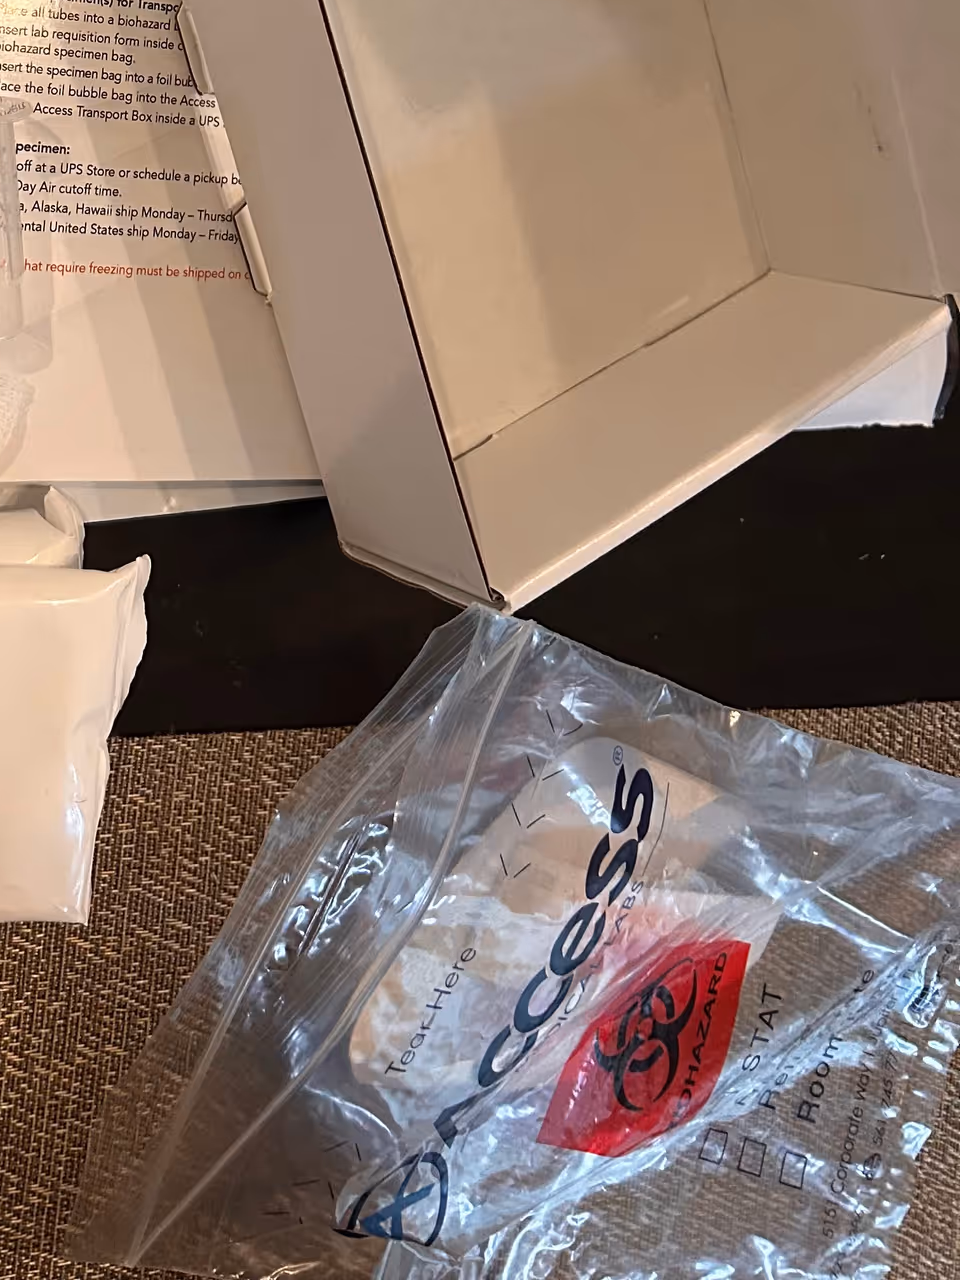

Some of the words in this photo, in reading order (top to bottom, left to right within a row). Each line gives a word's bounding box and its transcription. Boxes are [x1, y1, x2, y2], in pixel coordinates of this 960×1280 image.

[47, 7, 80, 22] tubes
[82, 10, 105, 24] into
[116, 13, 173, 31] biohazard
[51, 29, 111, 44] requisition
[113, 32, 140, 47] form
[142, 35, 177, 53] inside
[53, 47, 108, 61] specimen
[45, 65, 98, 80] specimen
[67, 83, 108, 100] bubble
[179, 93, 219, 108] Access
[31, 101, 73, 116] Access
[75, 104, 129, 123] Transport
[131, 108, 154, 126] Box
[197, 113, 220, 128] UPS
[59, 161, 83, 175] UPS
[85, 163, 115, 177] Store
[132, 166, 181, 181] schedule
[192, 170, 228, 188] pickup
[58, 182, 93, 195] cutoff
[30, 199, 71, 216] Alaska,
[74, 201, 113, 216] Hawaii
[114, 203, 139, 221] ship
[140, 205, 186, 223] Monday
[48, 220, 87, 234] United
[89, 222, 124, 236] States
[126, 224, 150, 241] ship
[151, 225, 197, 243] Monday
[44, 261, 86, 276] require
[88, 261, 134, 279] freezing
[135, 266, 163, 277] must
[182, 266, 226, 282] shipped
[742, 983, 783, 1072] STAT
[798, 1035, 844, 1124] Room
